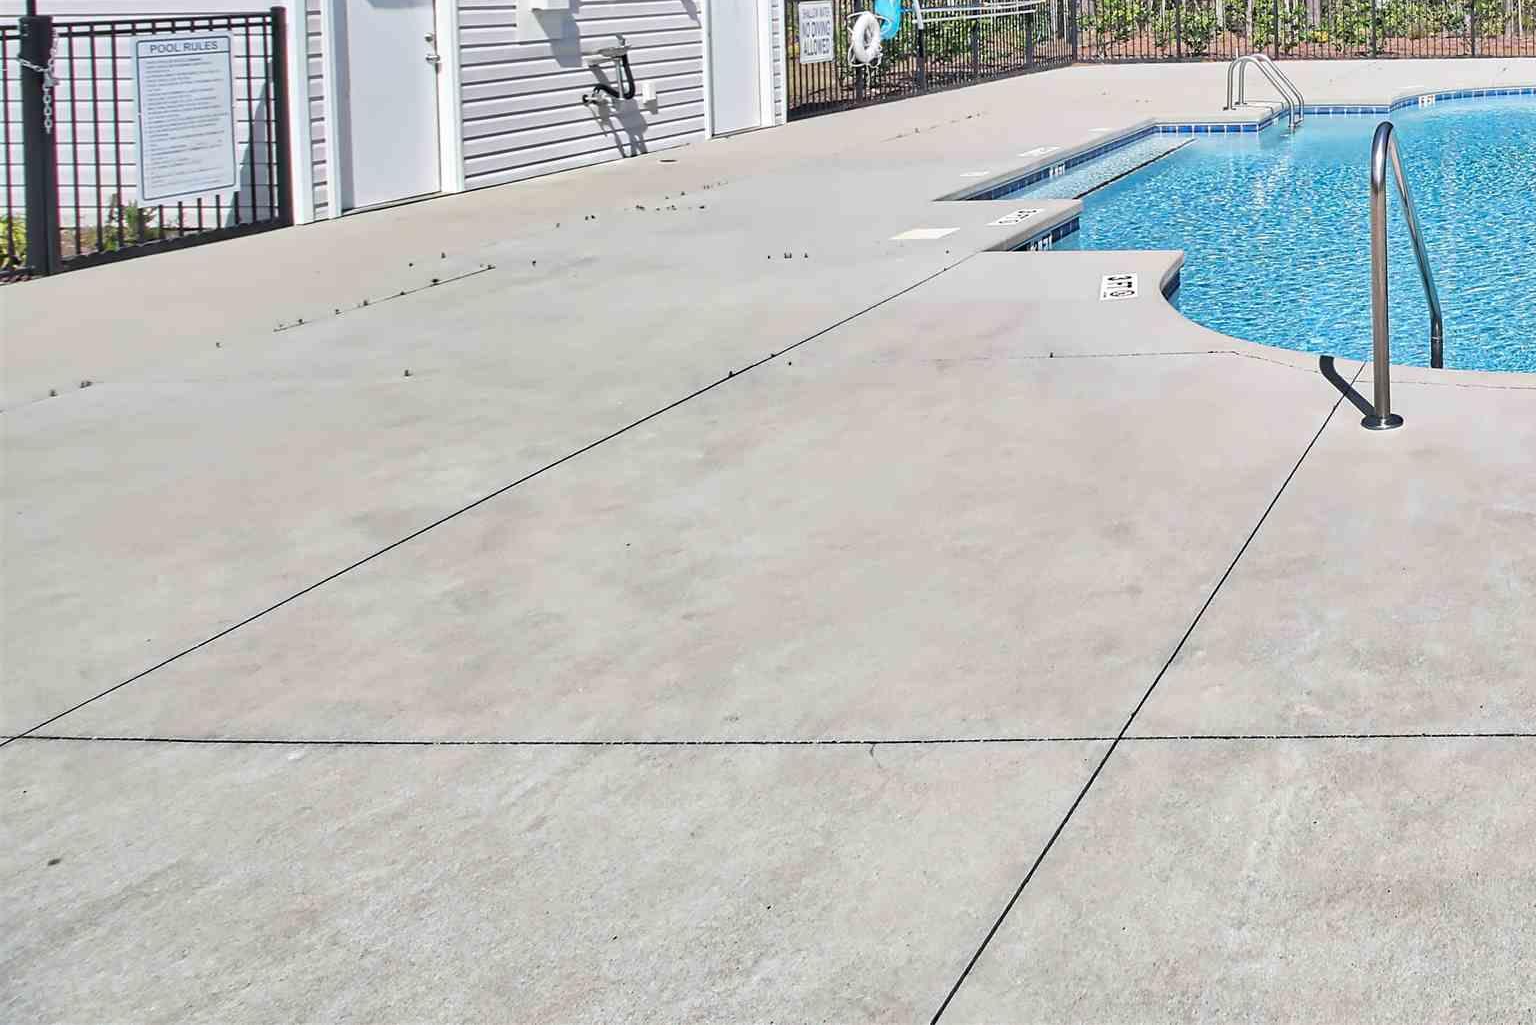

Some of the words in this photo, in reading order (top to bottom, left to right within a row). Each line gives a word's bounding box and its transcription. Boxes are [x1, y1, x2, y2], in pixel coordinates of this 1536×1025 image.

[150, 44, 181, 53] POOL
[184, 41, 218, 51] RULES
[803, 37, 830, 55] ALLOWED
